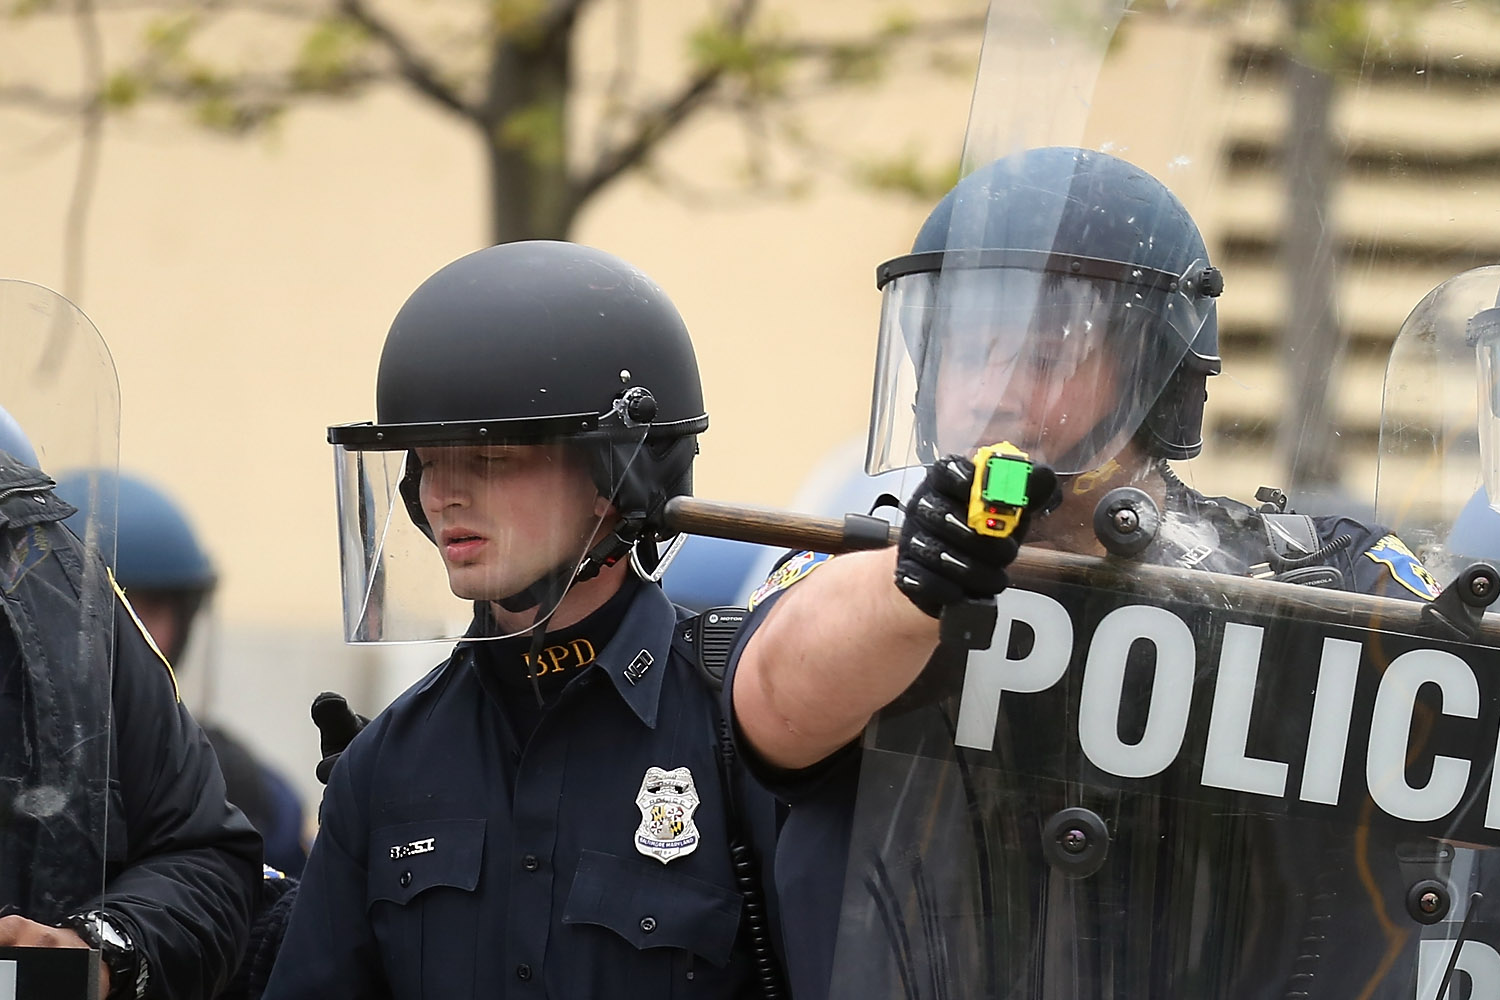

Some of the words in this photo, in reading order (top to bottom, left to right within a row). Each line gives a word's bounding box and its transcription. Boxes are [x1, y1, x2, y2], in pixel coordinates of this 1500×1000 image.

[521, 638, 596, 679] BPD
[649, 797, 687, 805] POLICE
[639, 836, 665, 848] BALTIMORE
[666, 837, 694, 848] MARYLAND
